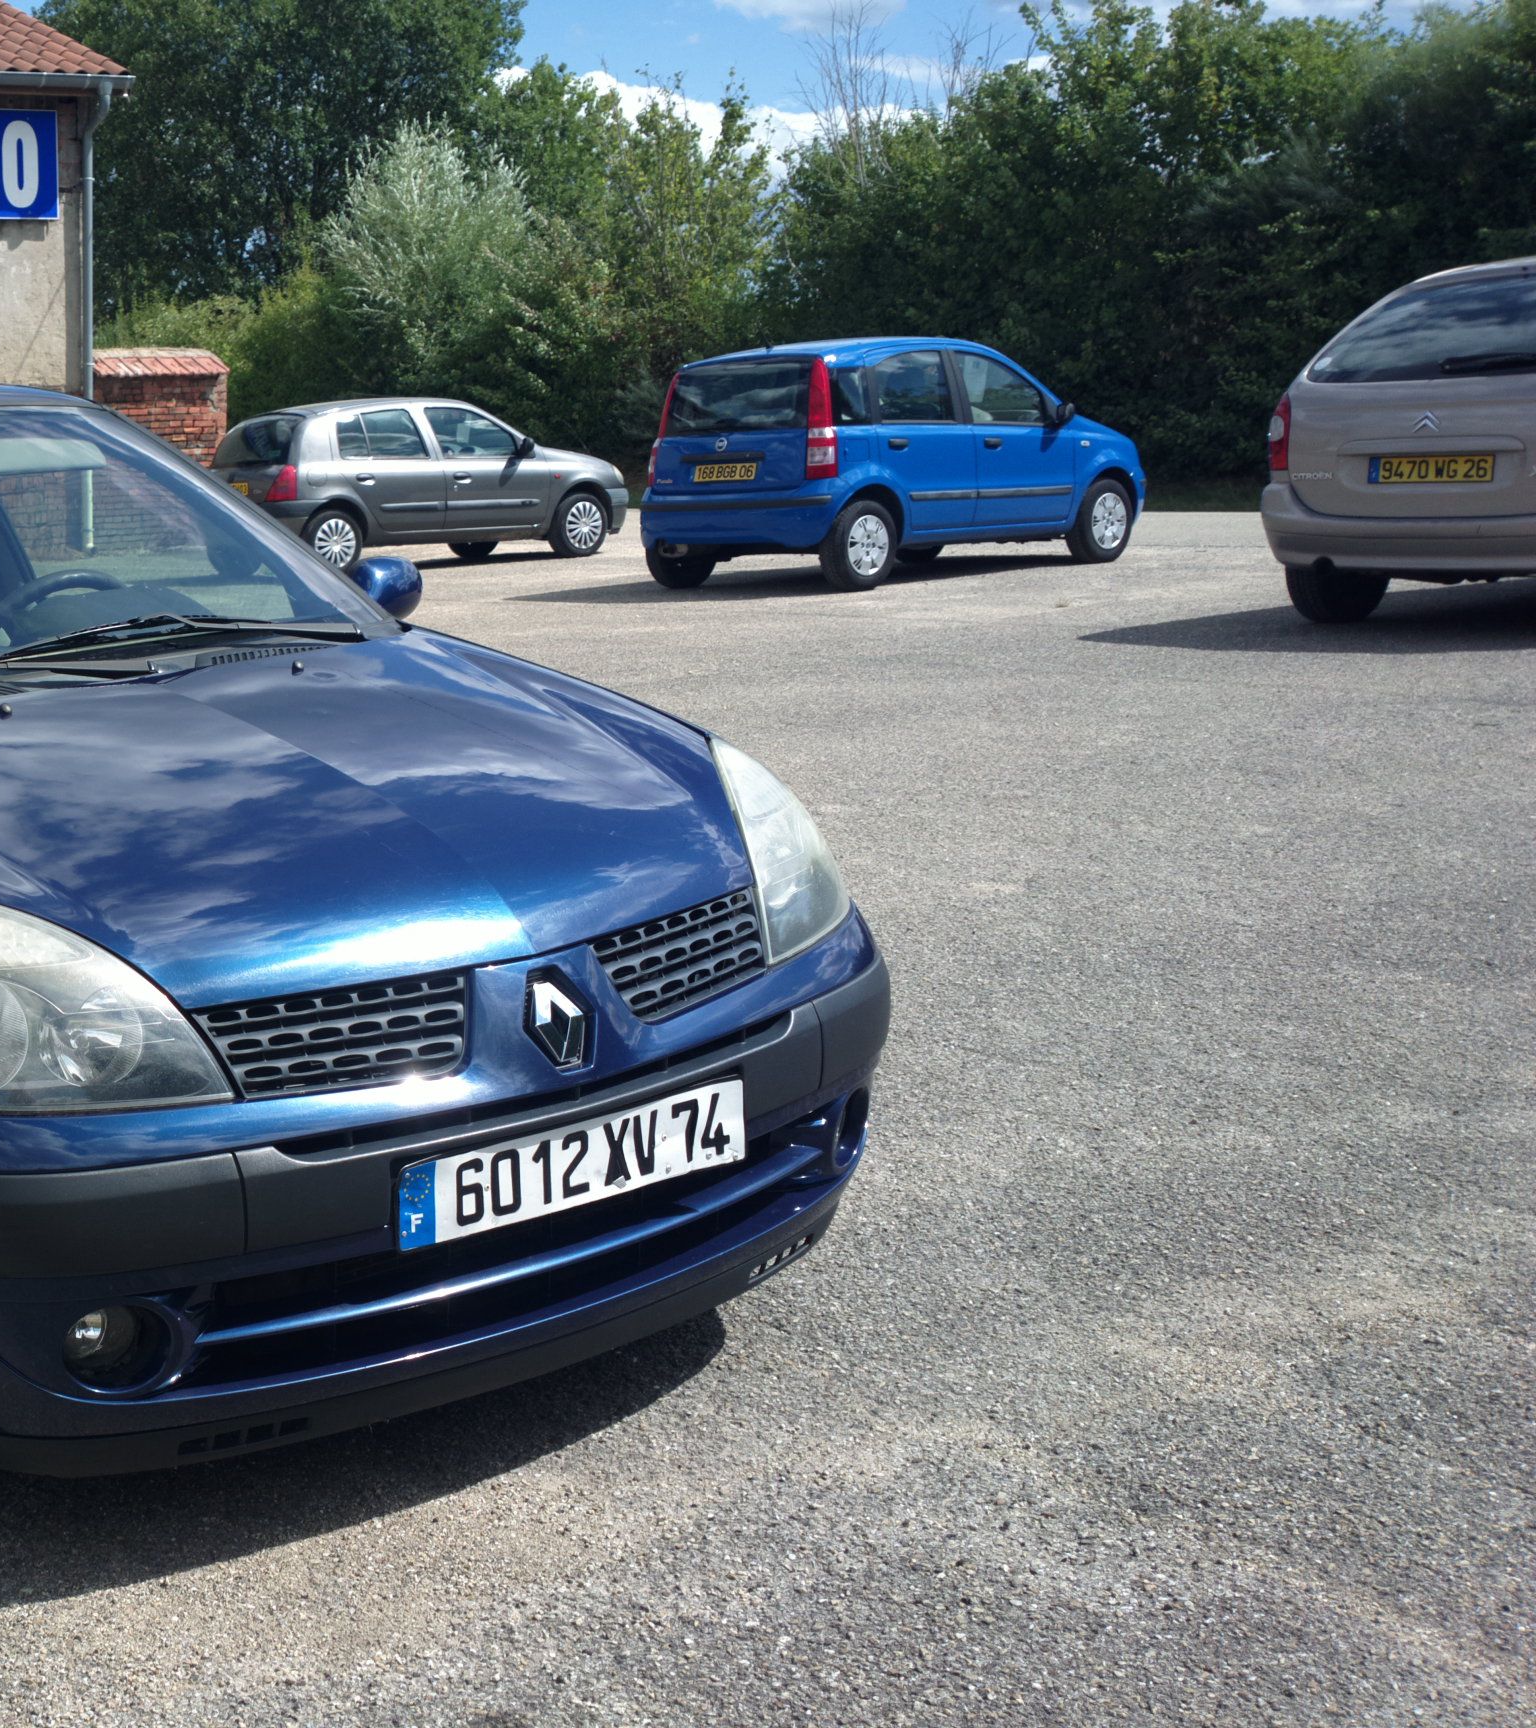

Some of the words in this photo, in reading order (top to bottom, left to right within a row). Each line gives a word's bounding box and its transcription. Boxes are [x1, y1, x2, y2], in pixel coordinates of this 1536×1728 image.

[697, 465, 715, 480] 168
[716, 464, 737, 479] BGB
[738, 464, 754, 478] 06
[1381, 459, 1429, 480] 9470
[1434, 459, 1458, 478] WG
[1462, 458, 1488, 478] 26
[410, 1213, 424, 1233] F
[456, 1130, 591, 1227] 6012
[603, 1109, 658, 1187] XV
[671, 1092, 731, 1163] 74
